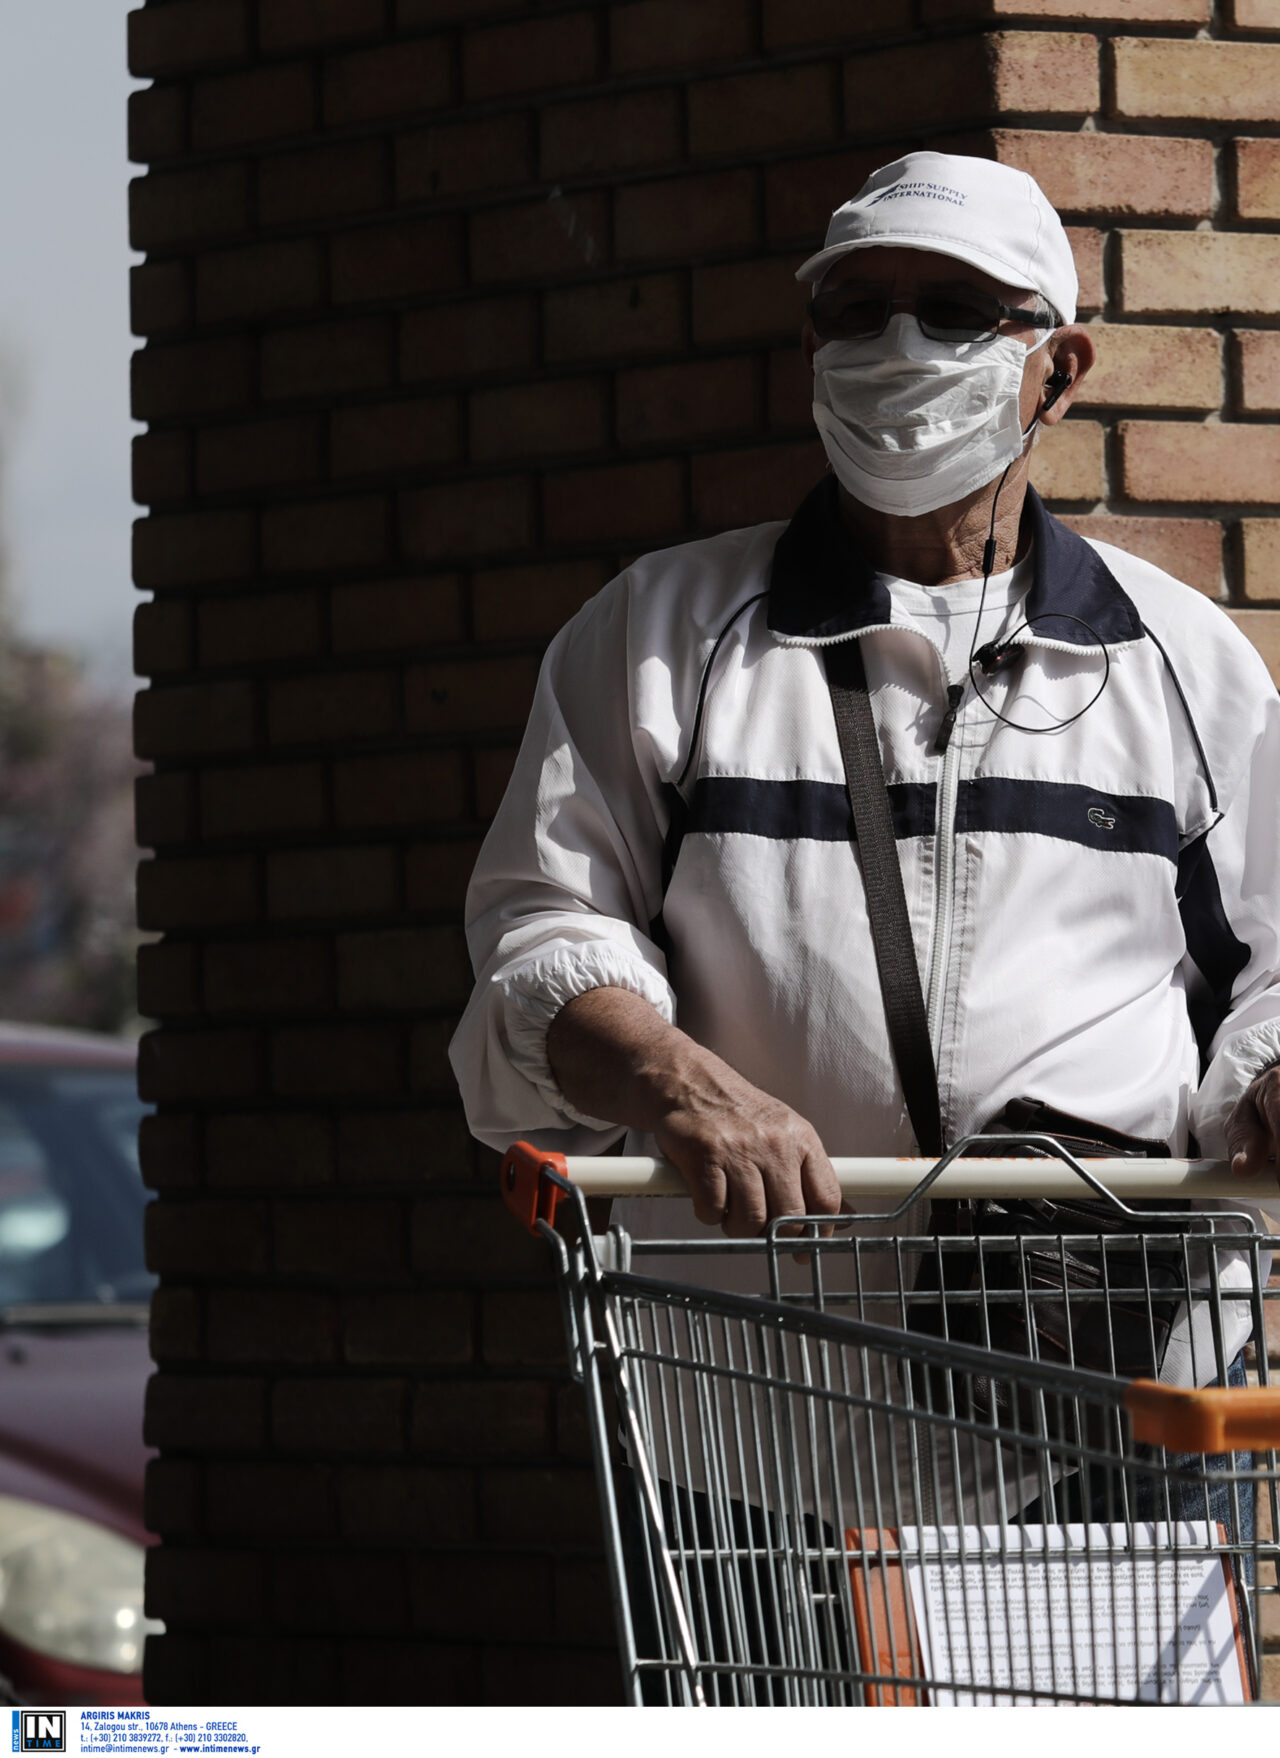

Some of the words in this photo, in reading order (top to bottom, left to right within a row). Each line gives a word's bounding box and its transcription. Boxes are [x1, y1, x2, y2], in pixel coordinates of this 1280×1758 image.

[883, 190, 965, 207] INTERNATIONAL
[898, 183, 925, 191] SHIP
[927, 183, 968, 200] SUPPLY
